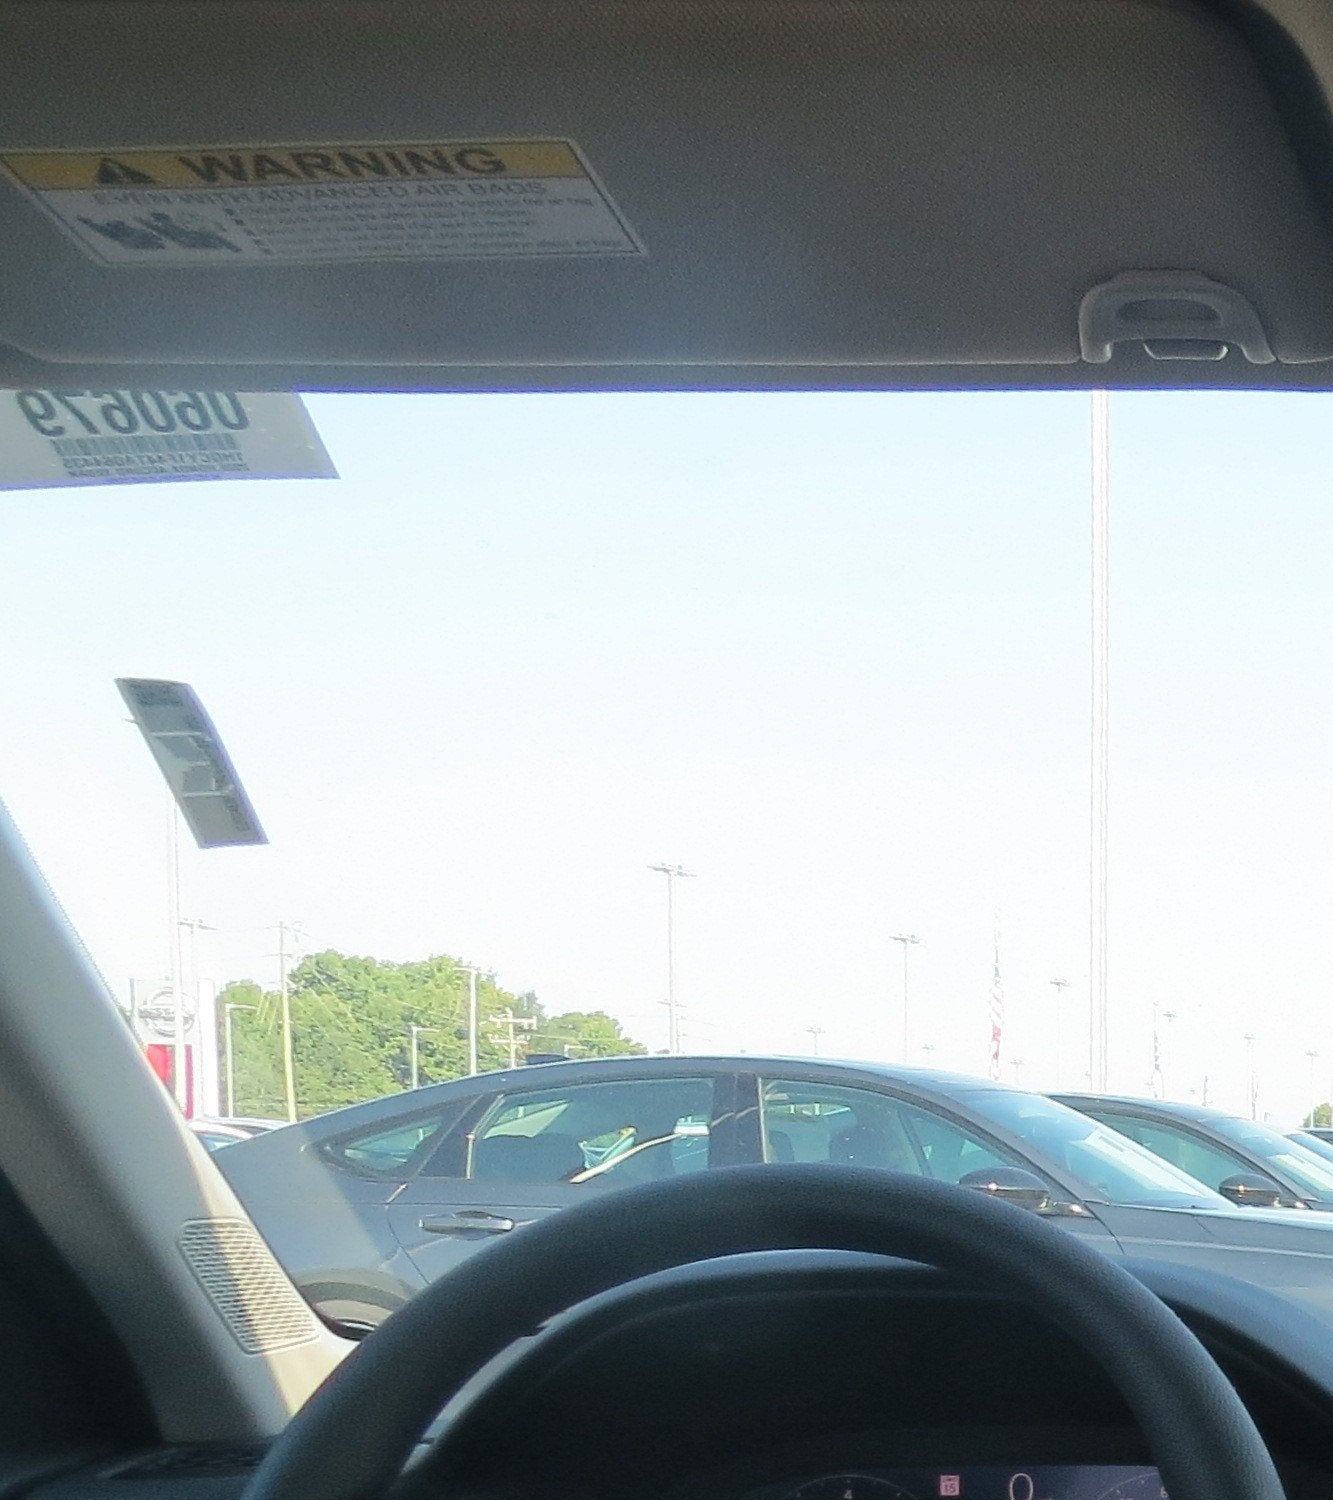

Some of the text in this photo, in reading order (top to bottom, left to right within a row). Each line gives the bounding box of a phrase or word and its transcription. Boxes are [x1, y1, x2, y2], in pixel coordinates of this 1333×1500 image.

[178, 147, 509, 184] WARNING
[254, 183, 408, 204] ADVANCED
[414, 182, 464, 197] AIR
[470, 180, 547, 196] BAGS
[844, 1489, 853, 1500] 4
